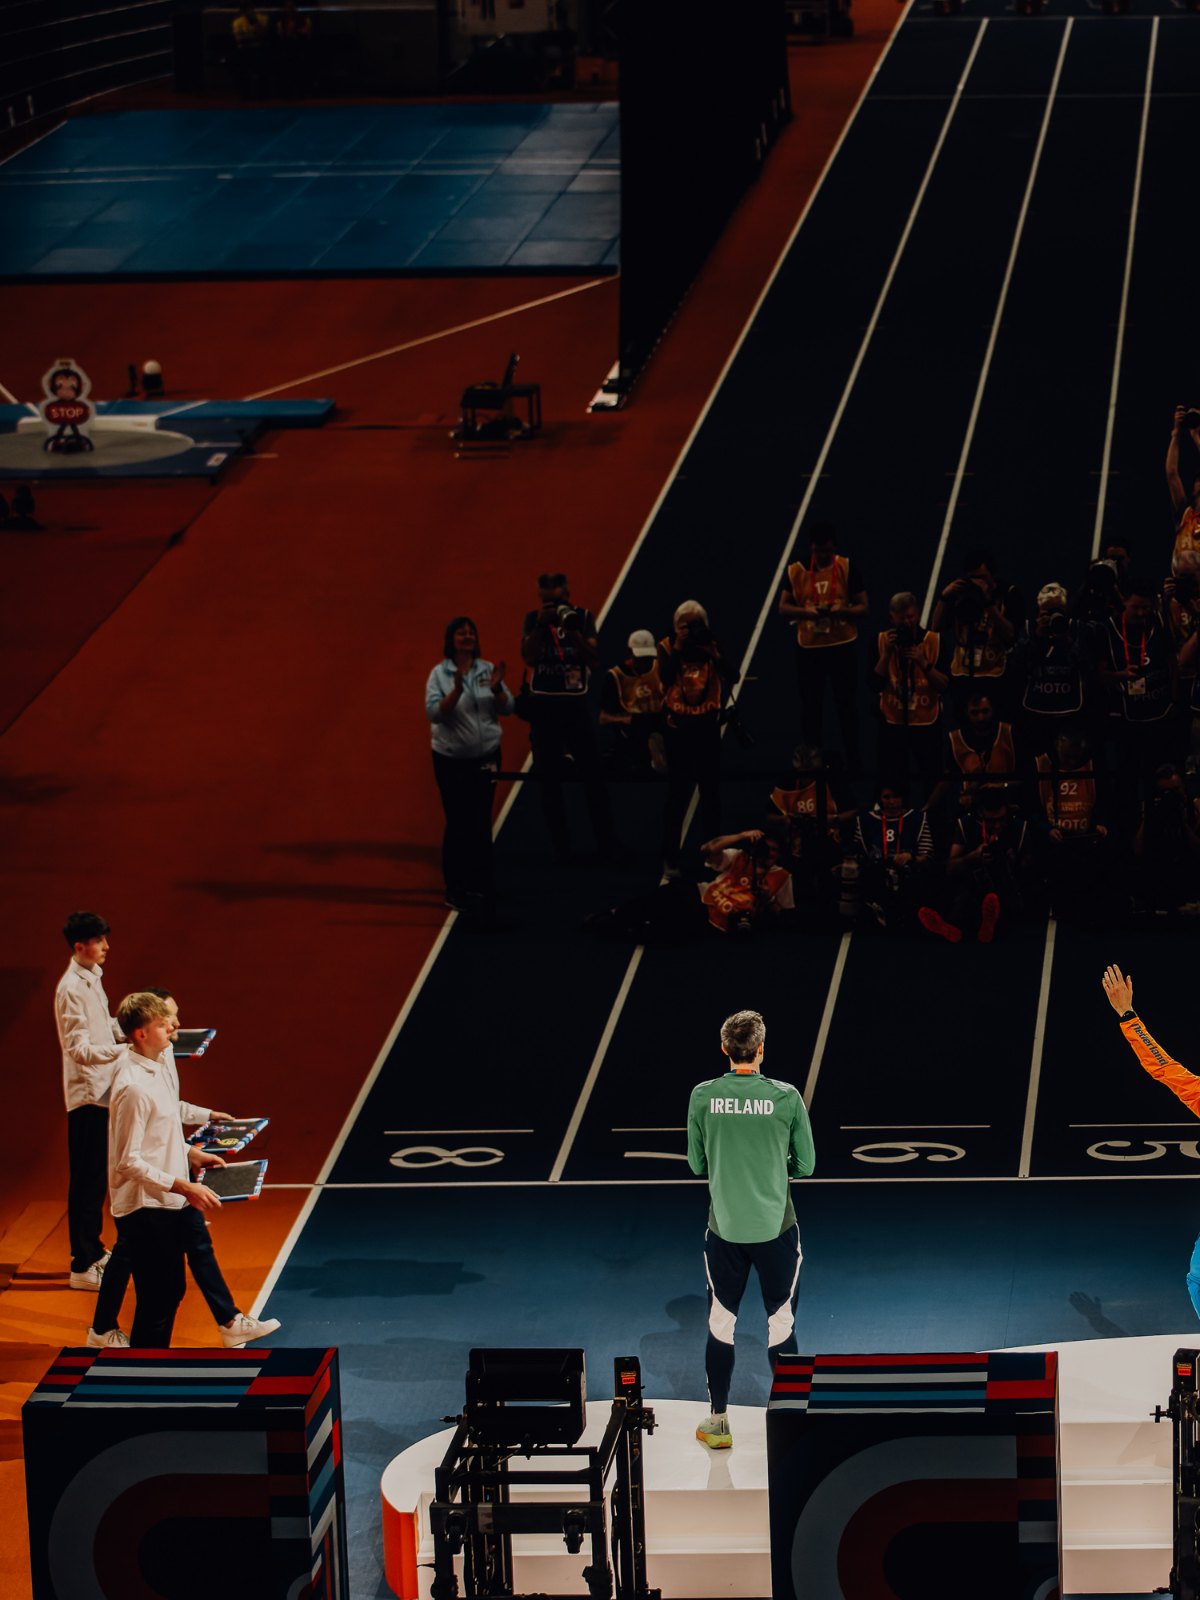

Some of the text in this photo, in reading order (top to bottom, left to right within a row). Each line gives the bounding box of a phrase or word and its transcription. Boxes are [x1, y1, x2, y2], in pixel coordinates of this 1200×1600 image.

[51, 407, 84, 418] STOP
[815, 581, 829, 594] 17
[1060, 782, 1078, 796] 92
[797, 799, 814, 813] 86
[885, 828, 896, 843] 8
[710, 1098, 774, 1115] IRELAND
[389, 1145, 505, 1169] 8
[851, 1141, 967, 1164] 6
